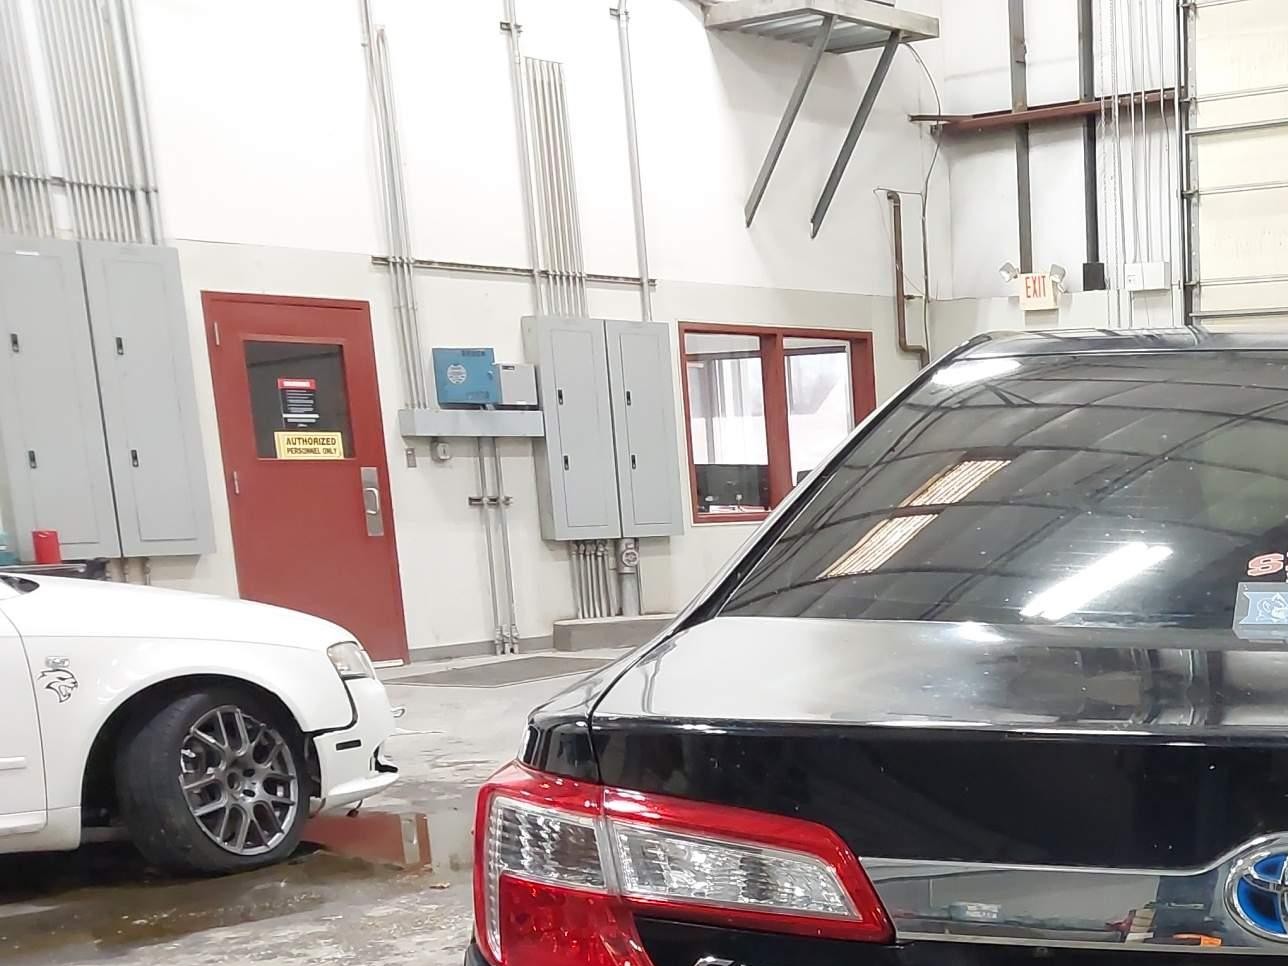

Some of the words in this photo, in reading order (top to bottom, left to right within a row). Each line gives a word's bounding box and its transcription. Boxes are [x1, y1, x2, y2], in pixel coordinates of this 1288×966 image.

[1025, 275, 1046, 298] EXIT
[286, 436, 337, 446] AUTHORIZED
[286, 447, 321, 455] PERSONNEL
[322, 447, 337, 455] ONLY
